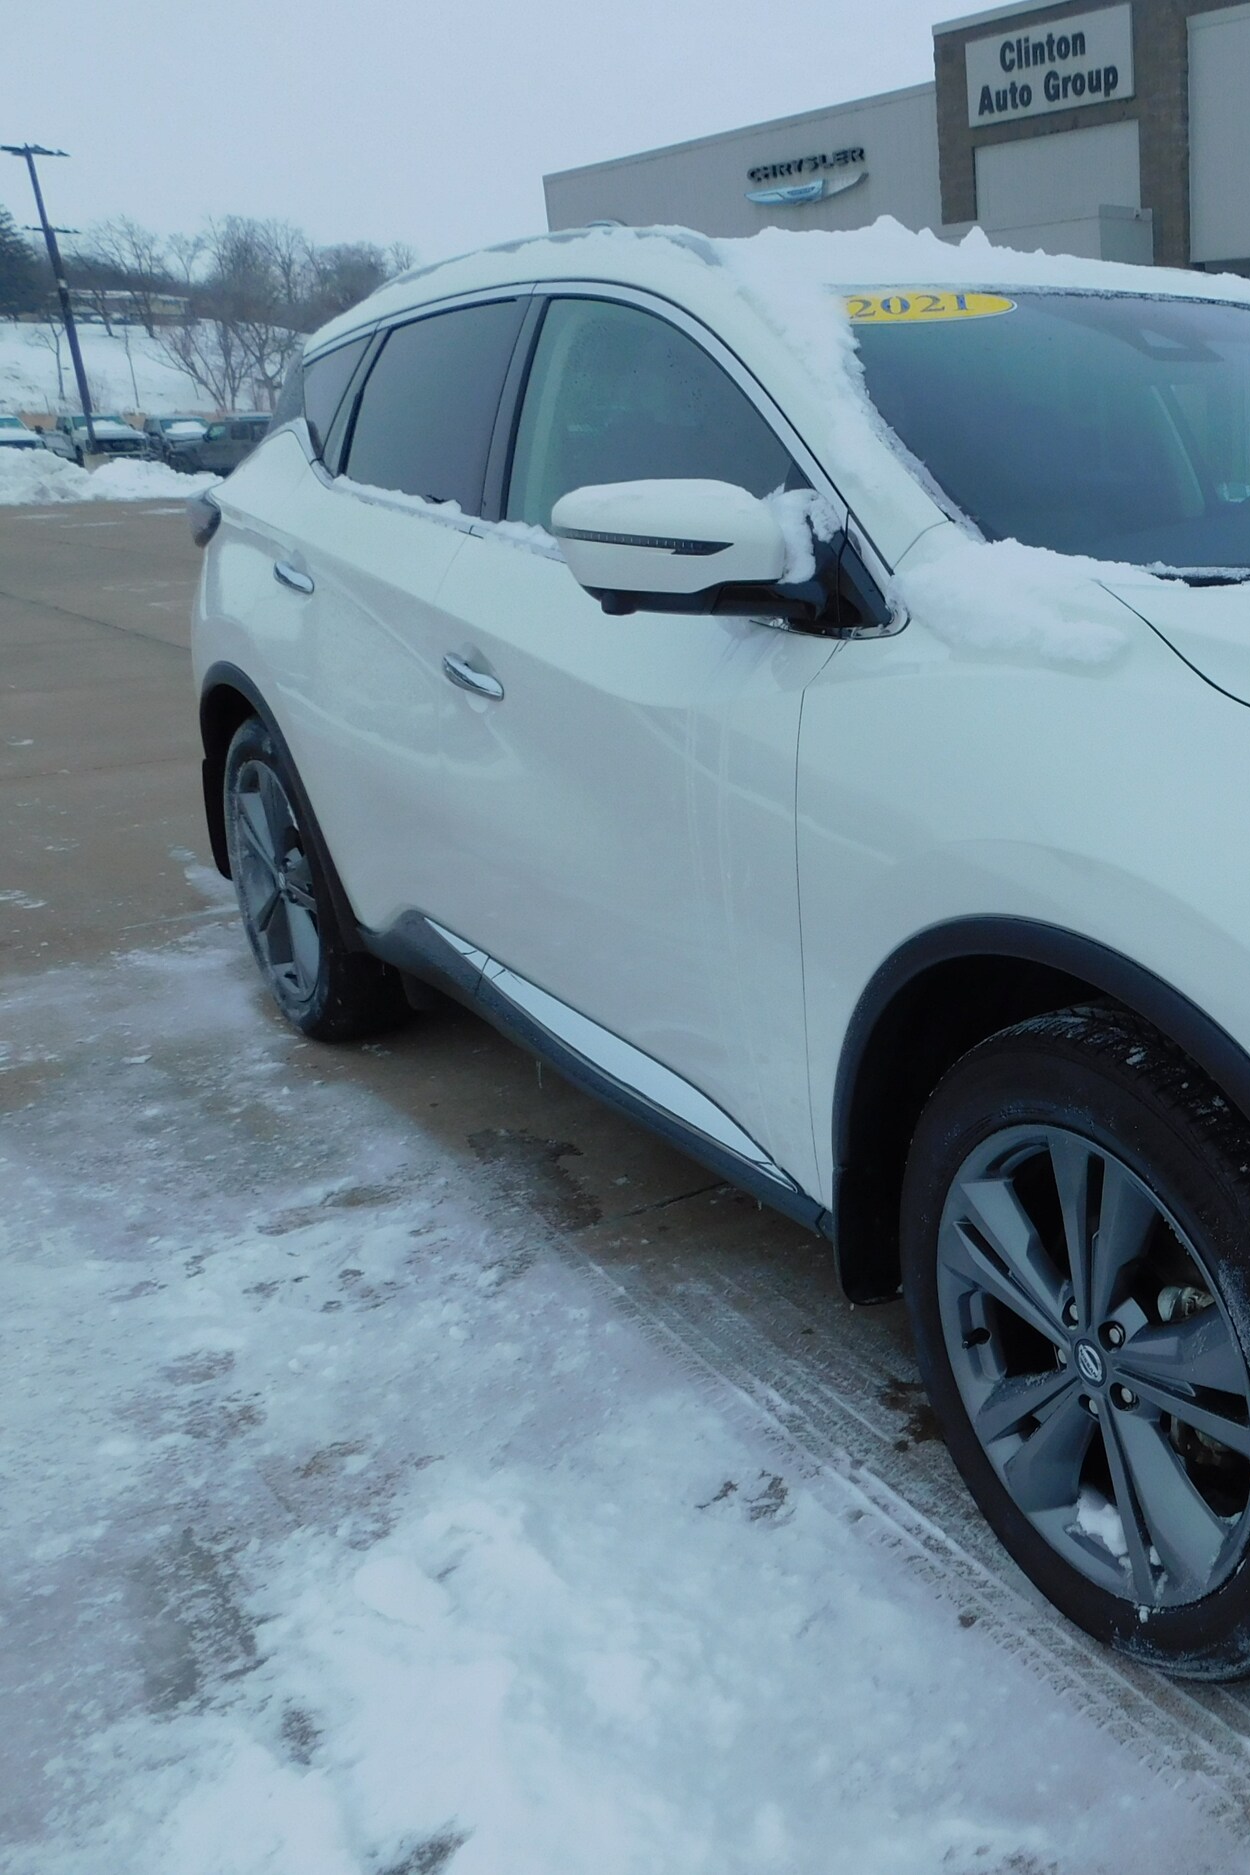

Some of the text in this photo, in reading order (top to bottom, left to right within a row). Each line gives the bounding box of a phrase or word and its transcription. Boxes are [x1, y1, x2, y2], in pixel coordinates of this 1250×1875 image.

[1000, 32, 1086, 72] Clinton
[978, 65, 1119, 116] Auto Group
[747, 147, 865, 182] CHRYSLER
[847, 294, 971, 320] 2021
